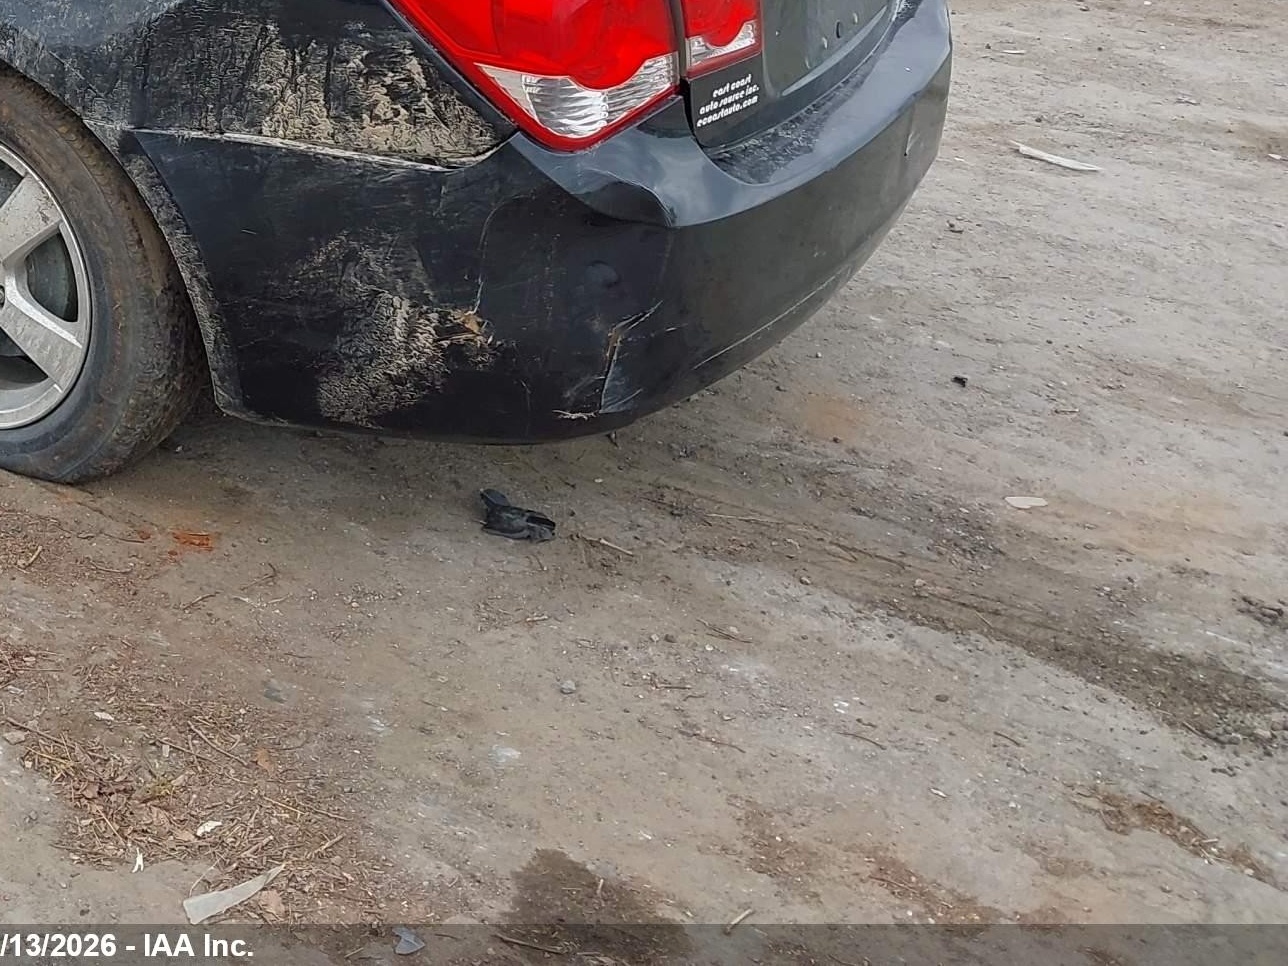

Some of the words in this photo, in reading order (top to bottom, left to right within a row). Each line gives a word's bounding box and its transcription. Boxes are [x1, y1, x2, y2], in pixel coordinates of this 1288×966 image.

[713, 82, 730, 98] east
[731, 73, 752, 90] coast
[696, 95, 759, 127] ecoastauto.com
[699, 101, 719, 115] auto
[719, 90, 745, 107] source
